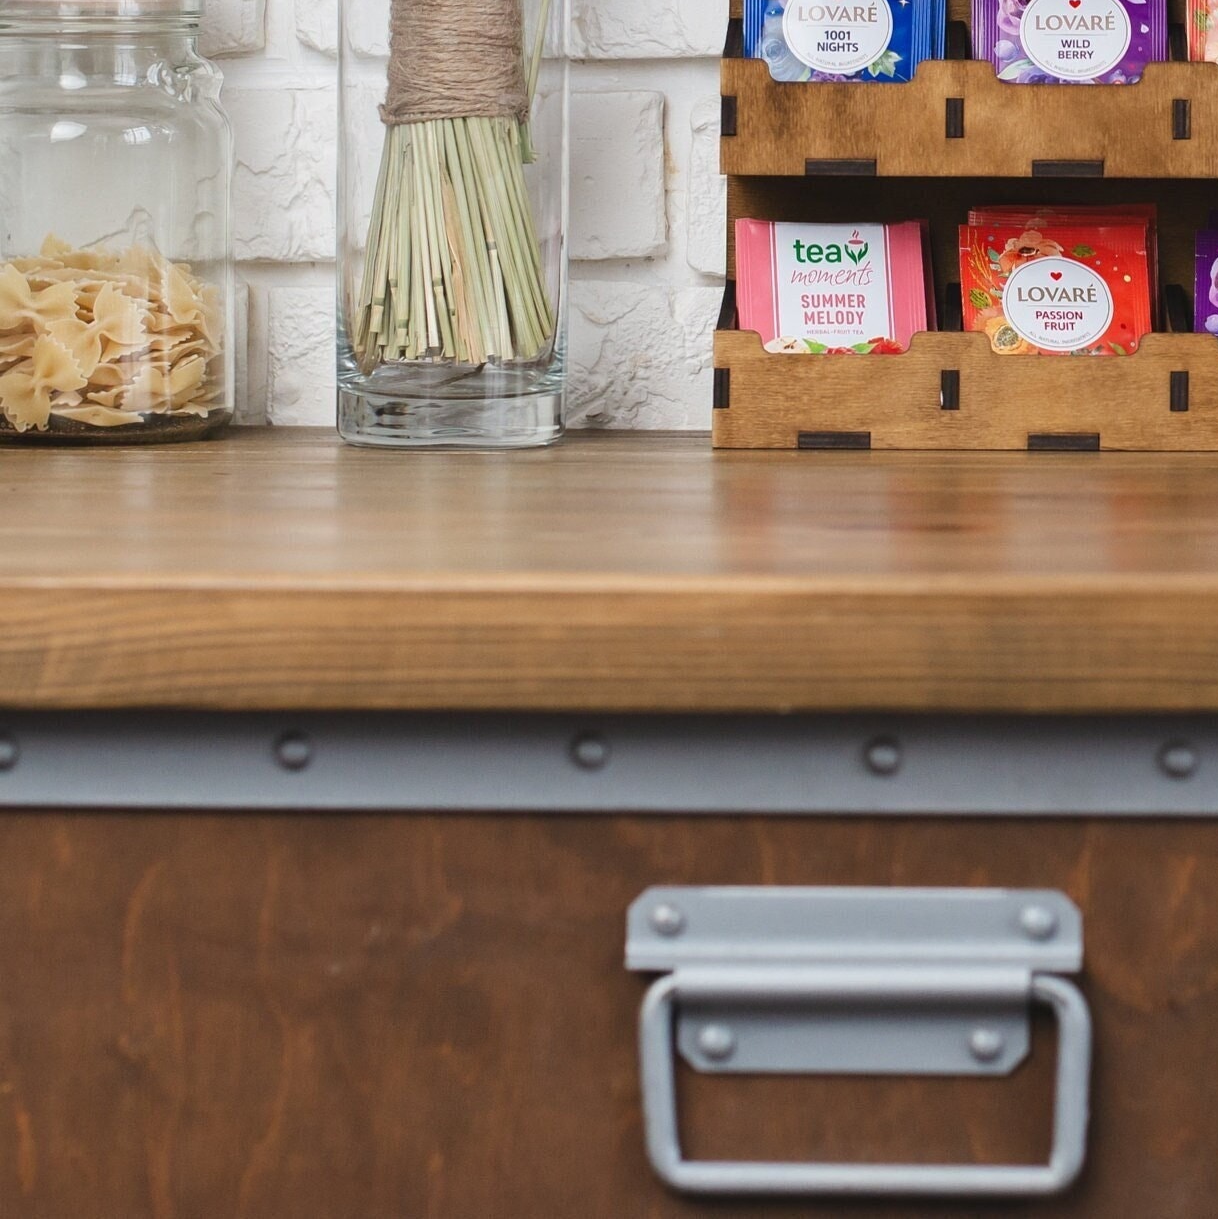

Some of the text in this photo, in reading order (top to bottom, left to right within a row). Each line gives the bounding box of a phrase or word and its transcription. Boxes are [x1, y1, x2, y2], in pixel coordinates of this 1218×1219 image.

[798, 1, 877, 22] LOVARÉ
[1036, 11, 1115, 31] LOVARÉ
[824, 31, 851, 40] 1001
[817, 42, 858, 52] NIGHTS
[1061, 40, 1090, 48] WILD
[1058, 51, 1094, 59] BERRY
[793, 239, 842, 263] tea
[791, 261, 873, 286] moments
[1017, 284, 1097, 303] LOVARÉ
[801, 294, 866, 308] SUMMER
[804, 311, 864, 325] MELODY
[1036, 311, 1083, 320] PASSION
[1044, 322, 1076, 331] FRUIT
